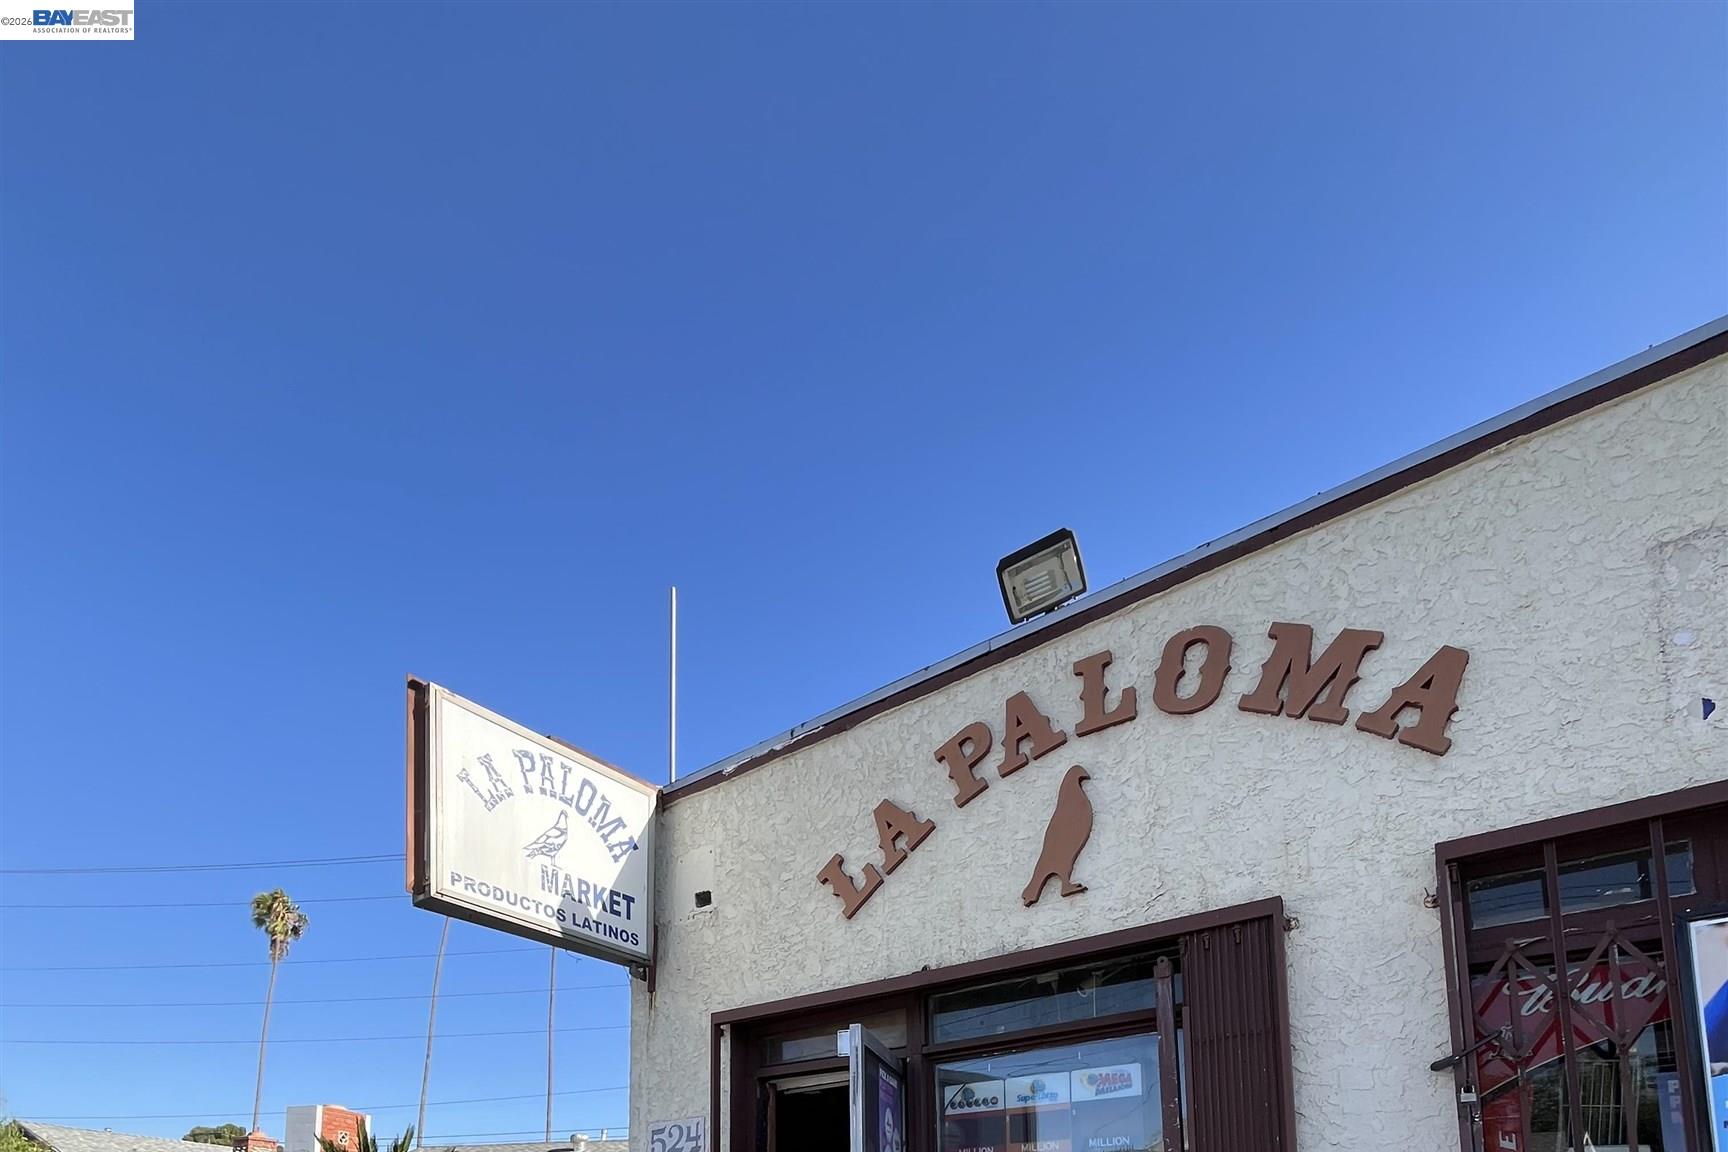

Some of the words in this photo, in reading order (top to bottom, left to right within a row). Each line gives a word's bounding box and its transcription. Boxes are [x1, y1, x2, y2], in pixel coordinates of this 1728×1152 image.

[816, 798, 935, 919] LA
[934, 622, 1469, 808] PALOMA
[456, 753, 514, 812] LA
[512, 749, 640, 864] PALOMA
[450, 871, 567, 923] PRODUCTOS
[573, 912, 639, 946] LATINOS
[541, 863, 636, 921] MARKET
[1021, 1142, 1060, 1152] MILLION
[1089, 1136, 1130, 1147] MILLION
